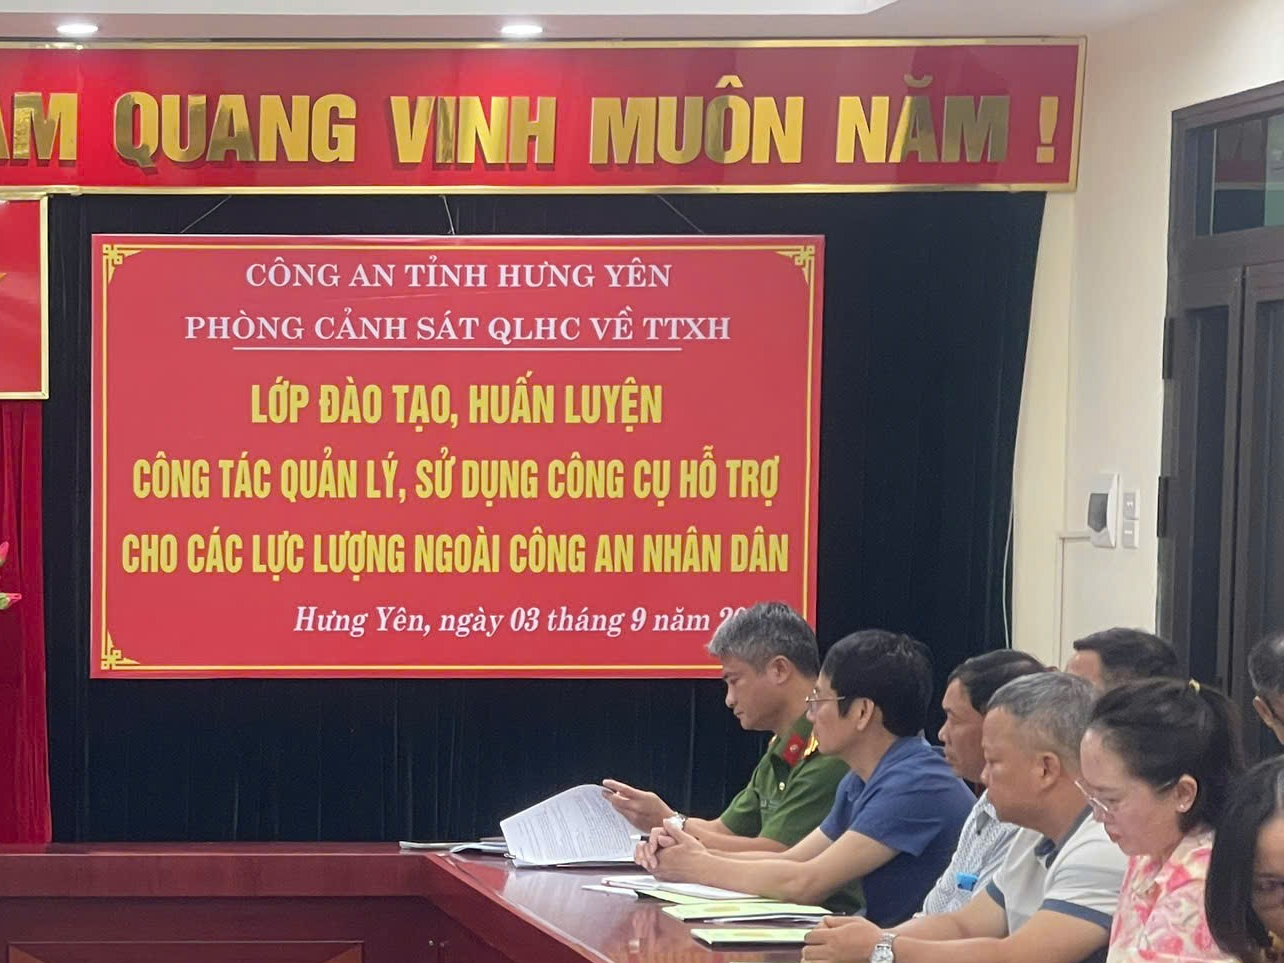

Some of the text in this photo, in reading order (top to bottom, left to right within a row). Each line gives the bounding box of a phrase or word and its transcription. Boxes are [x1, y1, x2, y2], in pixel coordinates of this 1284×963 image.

[113, 92, 355, 171] QUANG
[389, 95, 556, 166] VINH
[588, 75, 804, 166] MUÔN
[835, 77, 1009, 165] NĂM
[1036, 96, 1058, 163] !
[246, 255, 671, 287] CÔNG AN TỈNH HƯNG YÊN
[185, 306, 730, 345] PHÒNG CẢNH SÁT QLHC VỀ TTXH
[252, 371, 662, 432] LỚP ĐÀO TẠO, HUẤN LUYỆN
[133, 446, 780, 507] CÔNG TÁC QUẢN LÝ, SỬ DỤNG CÔNG CỤ HỖ TRỢ
[122, 526, 788, 581] CHO CÁC LỰC LƯỢNG NGOÀI CÔNG AN NHÂN DÂN
[294, 606, 367, 637] Hưng
[377, 607, 430, 636] Yên,
[439, 607, 504, 637] ngày
[510, 607, 540, 631] 03
[548, 606, 624, 637] tháng
[631, 607, 646, 631] 9
[653, 608, 710, 632] năm
